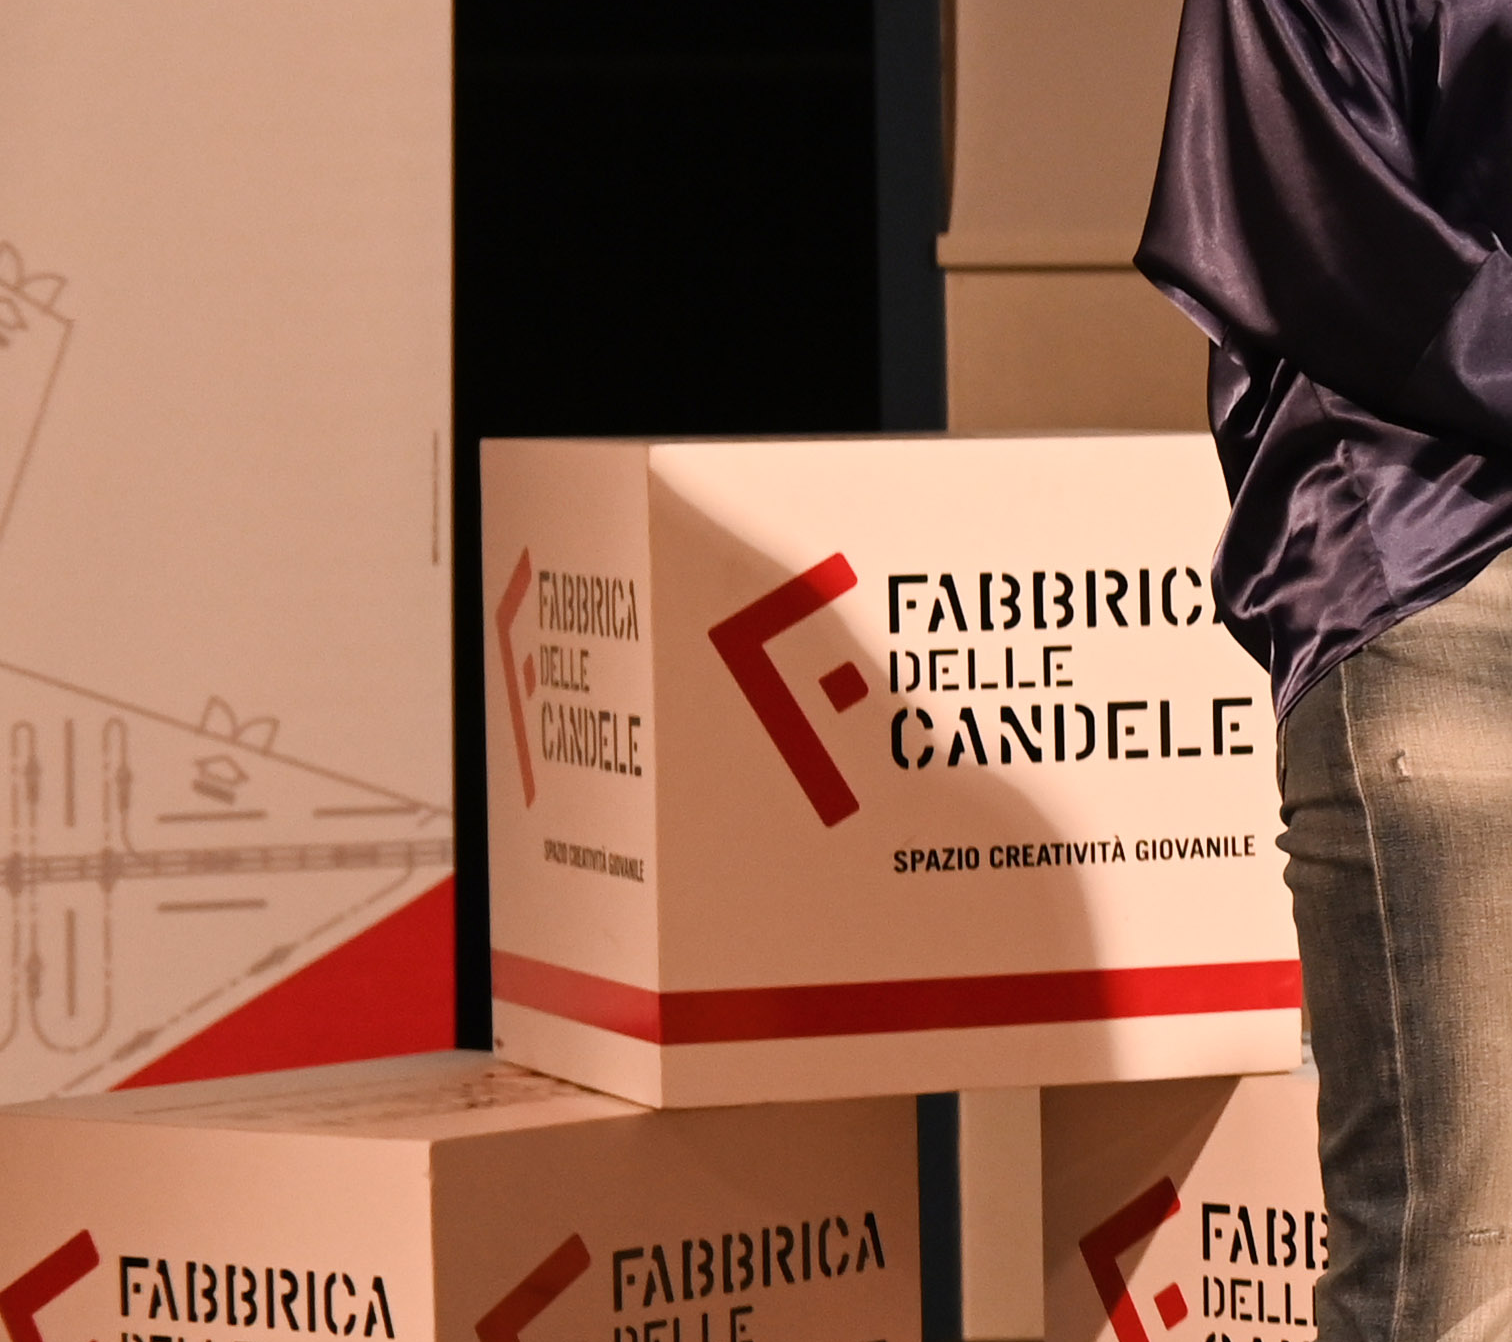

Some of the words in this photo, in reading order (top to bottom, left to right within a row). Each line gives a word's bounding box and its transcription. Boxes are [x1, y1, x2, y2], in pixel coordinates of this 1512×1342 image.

[538, 570, 640, 642] FABBRICA
[888, 566, 1224, 636] FABBRIC
[539, 644, 591, 695] DELLE
[890, 644, 1075, 695] DELLE
[541, 705, 643, 778] CANDELE
[890, 696, 1256, 770] CANDELE
[893, 845, 981, 875] SPAZIO
[988, 835, 1127, 871] CREATIVITÀ
[1135, 834, 1256, 863] GIOVANILE
[119, 1254, 396, 1340] FABBRICA
[612, 1211, 887, 1313] FABBRICA
[1203, 1275, 1317, 1327] DELL
